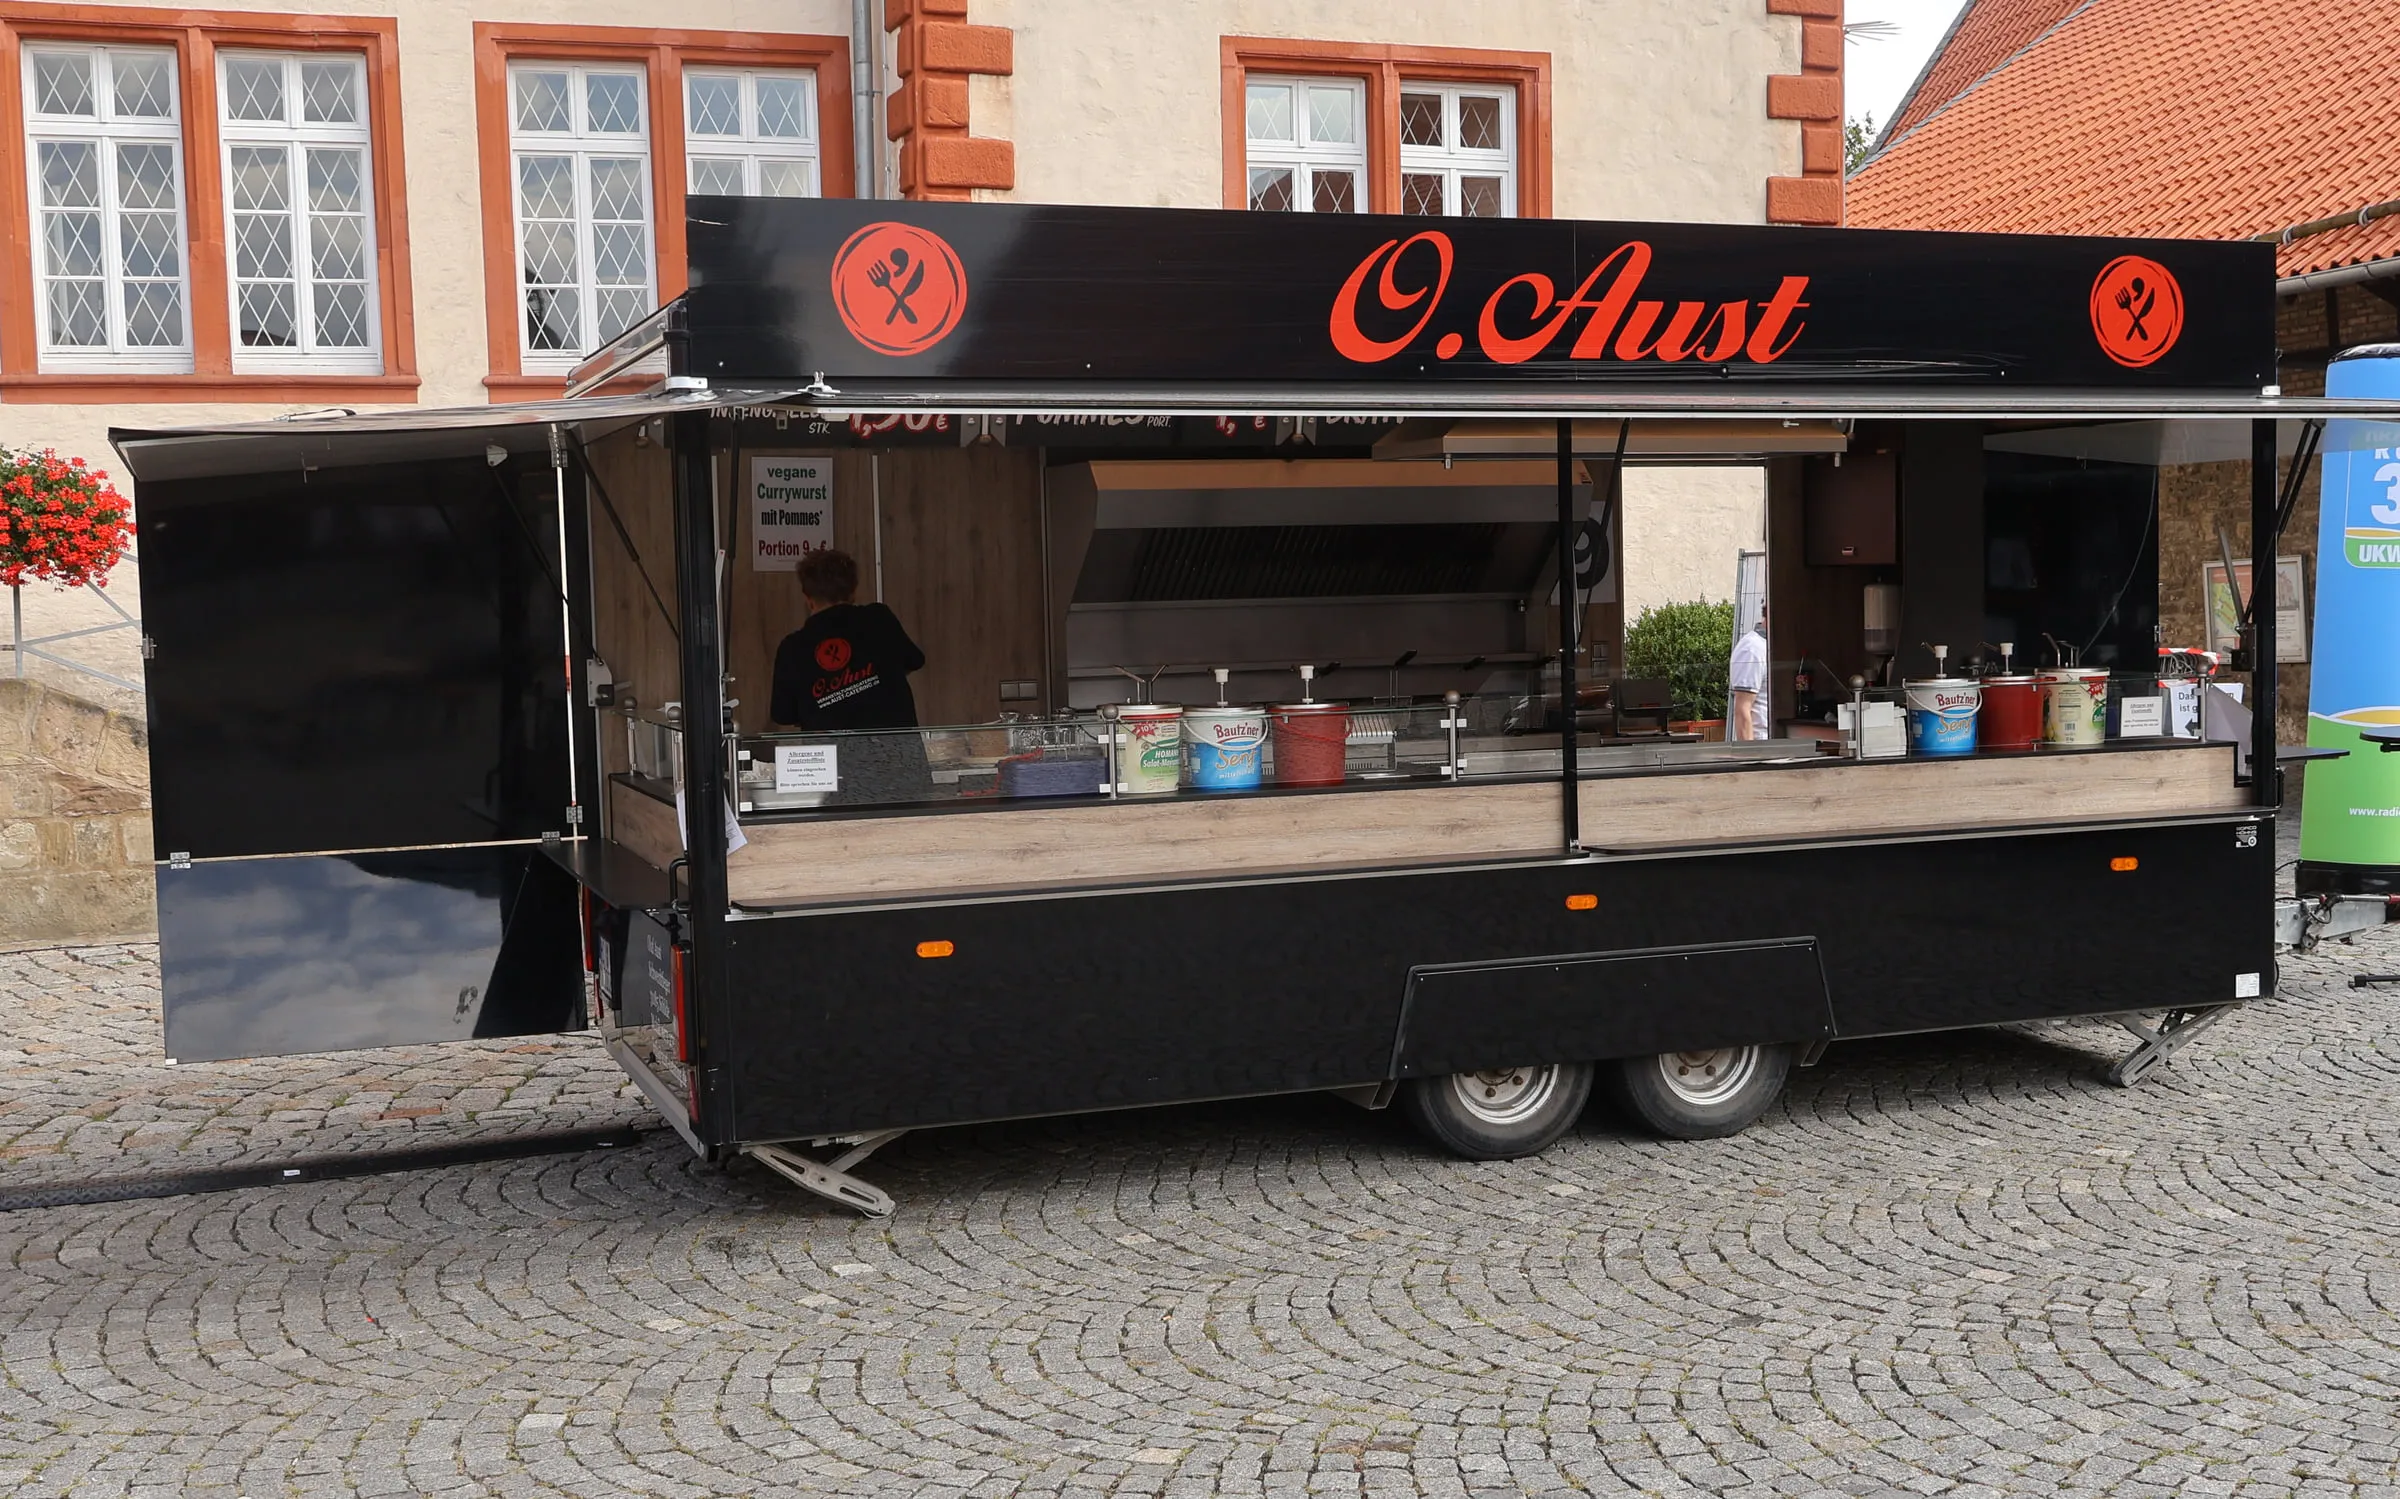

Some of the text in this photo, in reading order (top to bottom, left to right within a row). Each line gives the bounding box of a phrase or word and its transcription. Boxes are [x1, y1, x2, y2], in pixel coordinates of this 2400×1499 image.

[767, 467, 817, 482] vegane
[757, 483, 827, 504] Currywurst
[761, 509, 778, 526] mit
[758, 540, 800, 556] Portion
[1213, 722, 1259, 738] Bautz'ner
